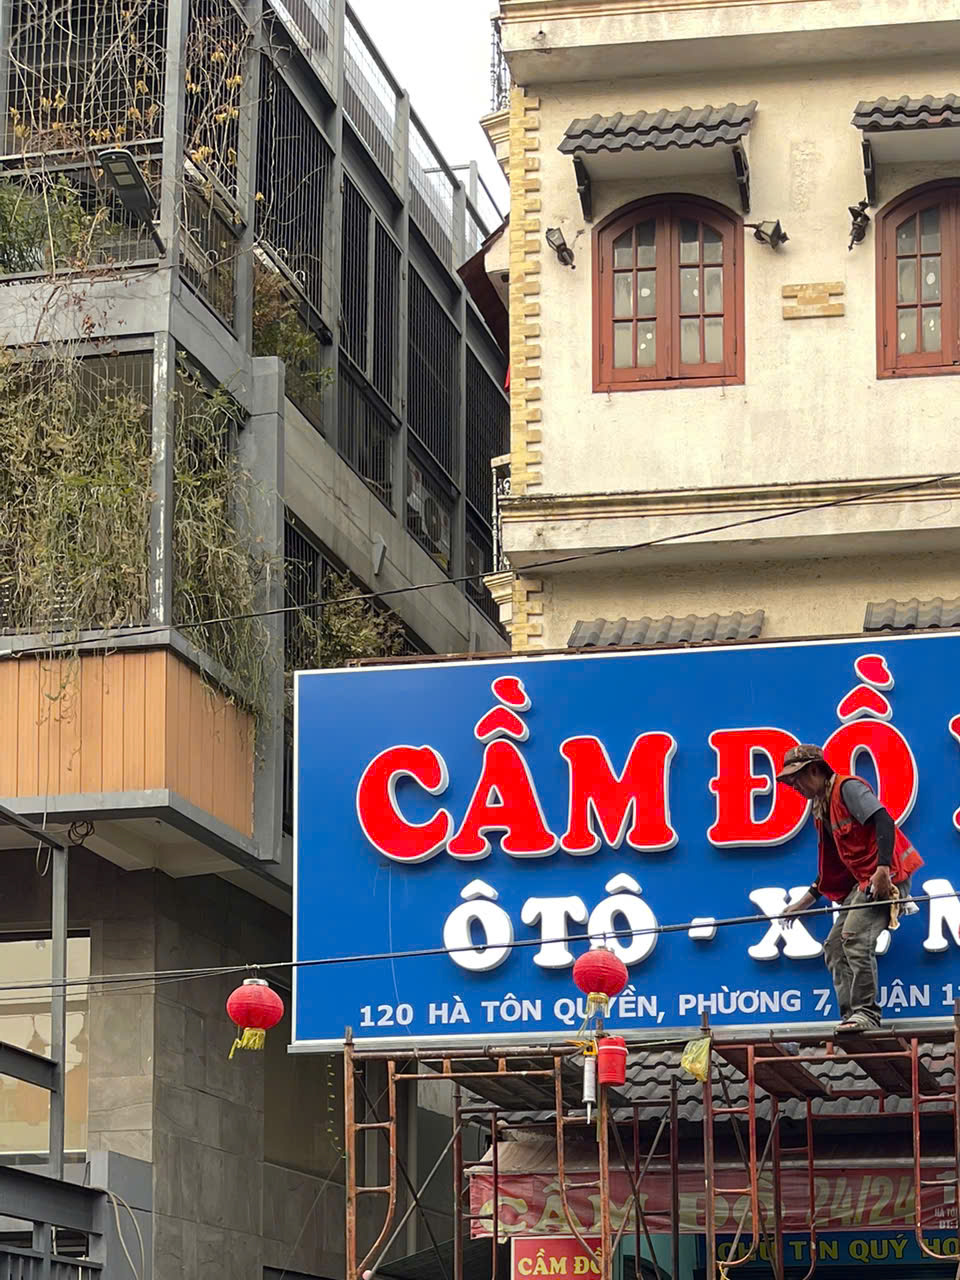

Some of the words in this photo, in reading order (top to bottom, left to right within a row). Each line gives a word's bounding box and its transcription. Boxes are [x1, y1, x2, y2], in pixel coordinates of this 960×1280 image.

[356, 675, 679, 864] CẦM
[706, 654, 919, 848] ĐỒ
[443, 873, 659, 973] ÔTÔ
[360, 1004, 414, 1027] 120
[429, 995, 471, 1025] HÀ
[481, 992, 542, 1022] TÔN
[812, 989, 832, 1017] 7,
[874, 978, 930, 1013] UẬN
[517, 1247, 567, 1276] CẦM
[849, 1233, 909, 1263] QUÝ
